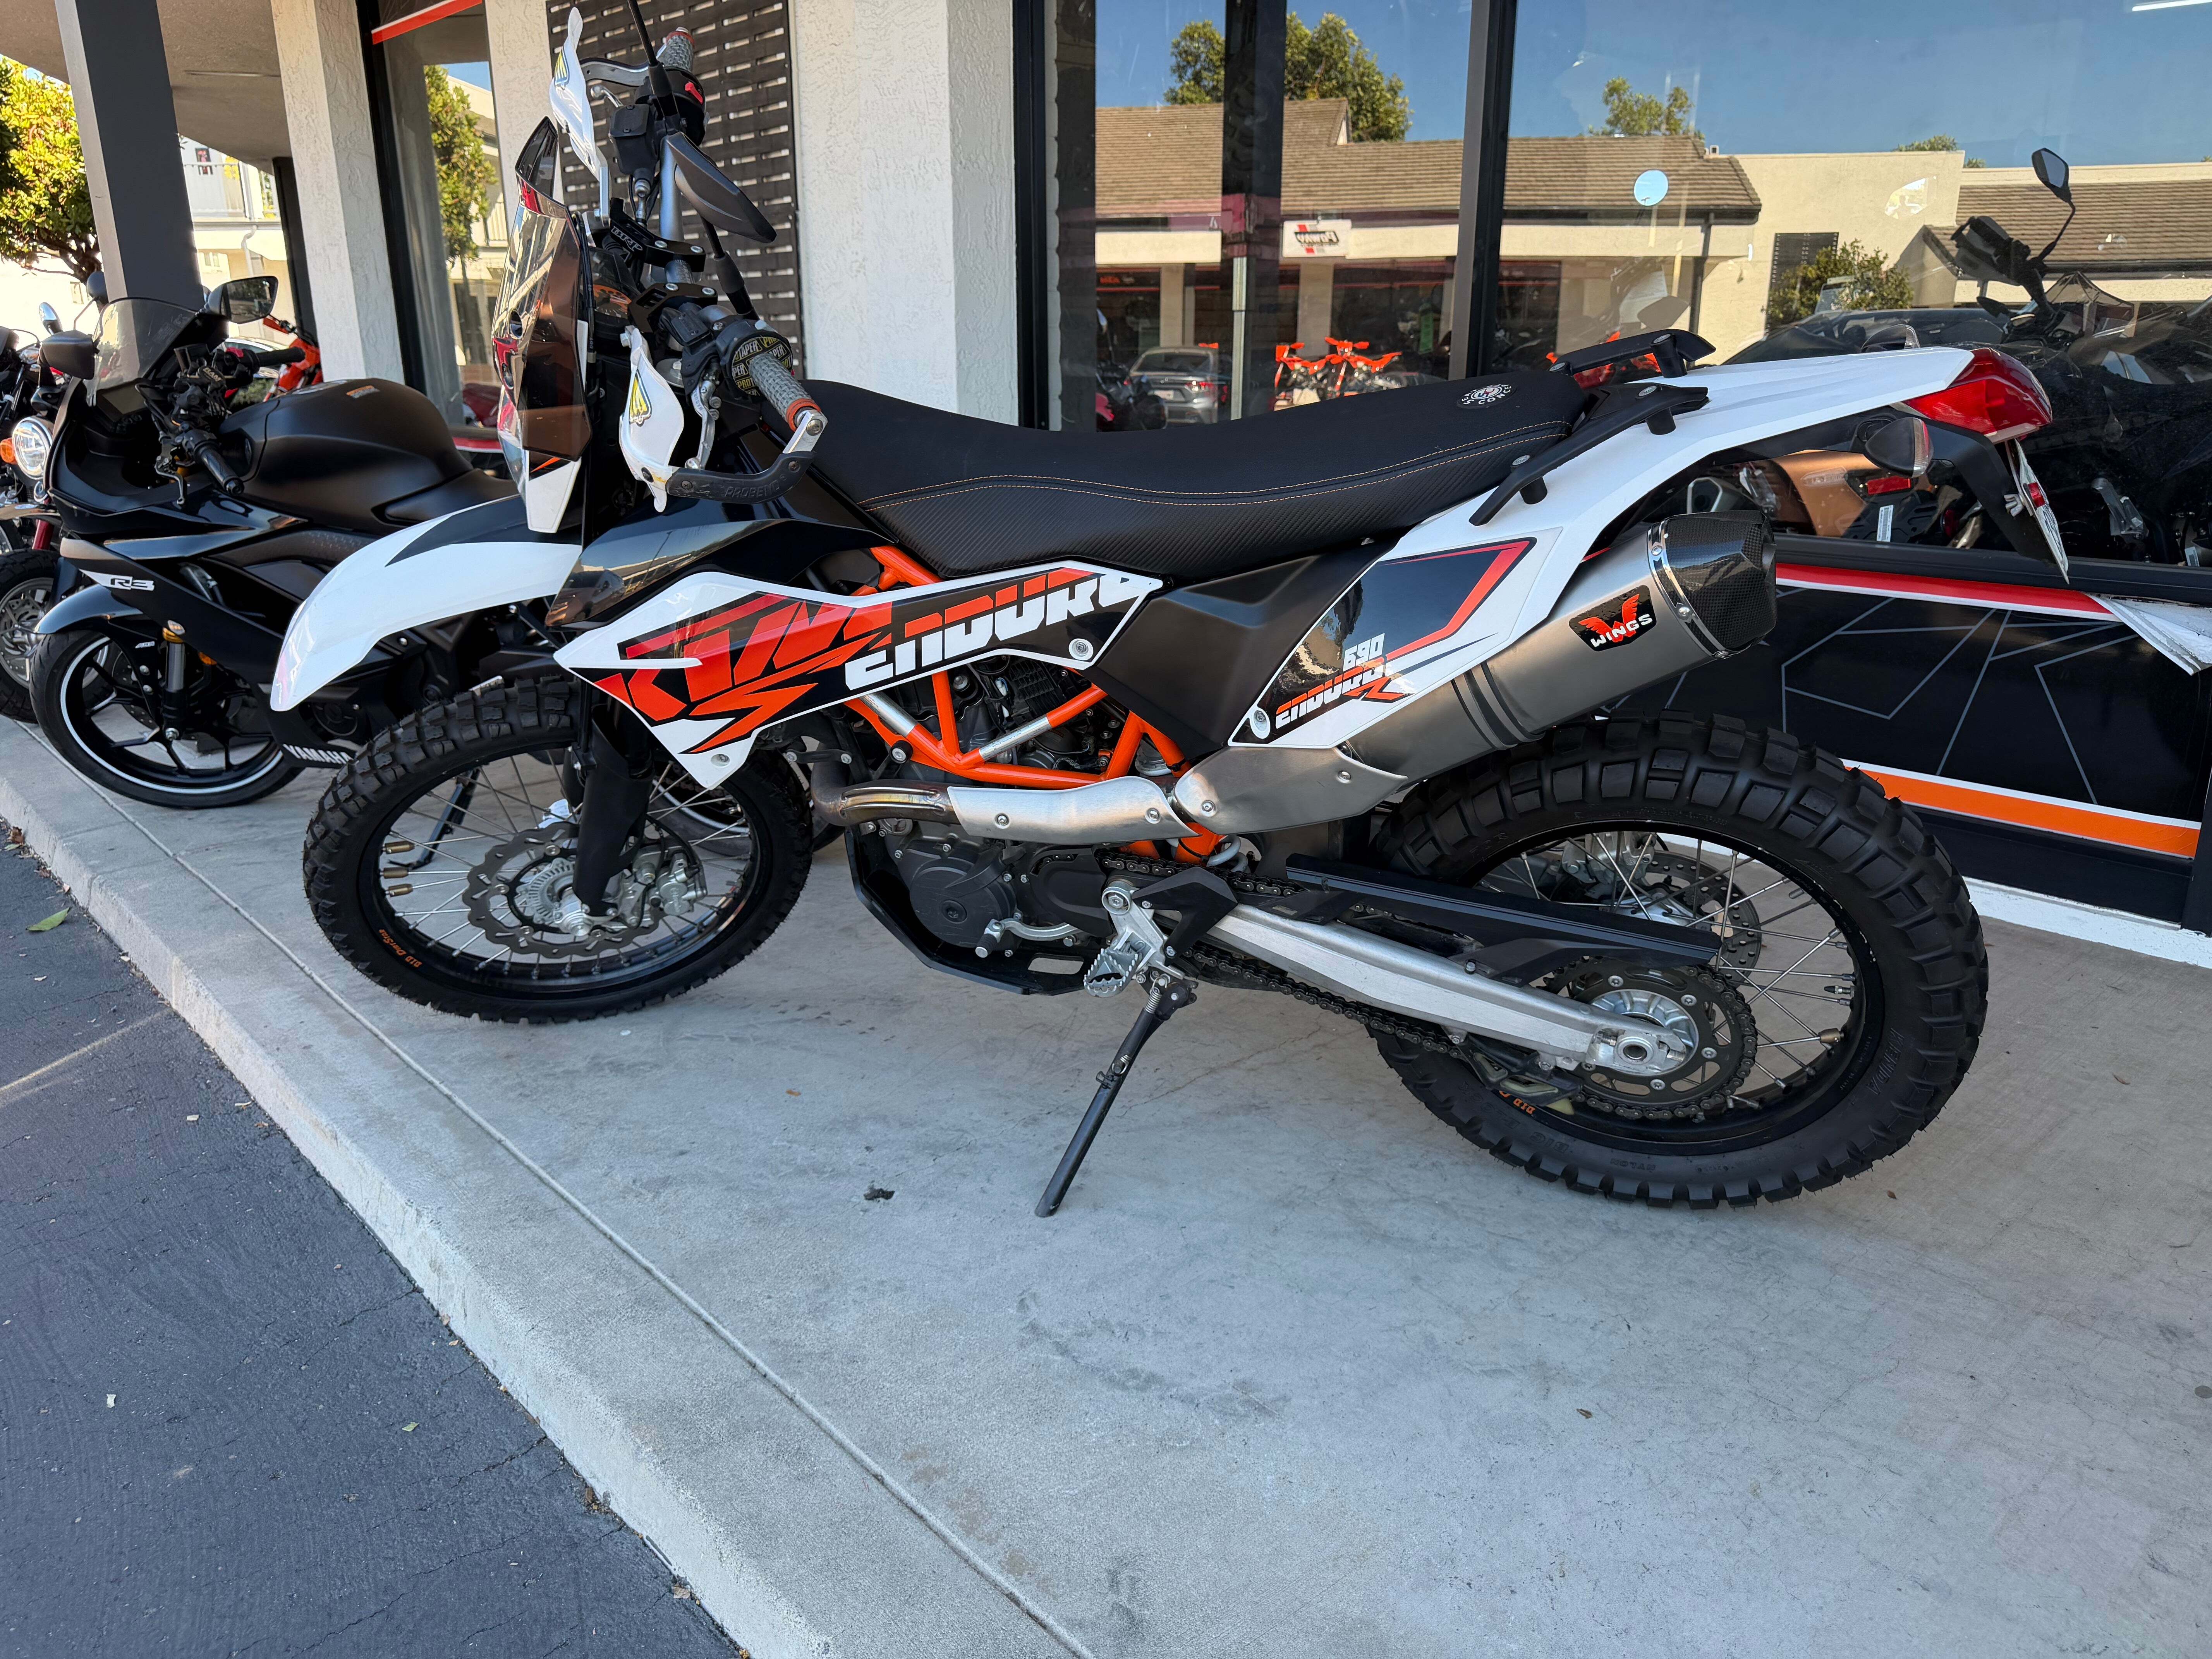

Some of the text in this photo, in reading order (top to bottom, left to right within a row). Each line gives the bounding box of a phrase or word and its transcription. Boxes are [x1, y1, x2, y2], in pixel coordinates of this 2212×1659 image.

[111, 577, 155, 591] R3
[1590, 613, 1653, 647] WINGS
[1343, 633, 1385, 672] 690
[1276, 657, 1385, 729] ENDURO
[282, 743, 354, 764] YAMAHA
[405, 955, 422, 967] DID
[1866, 1027, 1905, 1096] KENDA
[1513, 1097, 1536, 1115] DID
[1529, 1131, 1570, 1155] BIG
[1609, 1157, 1656, 1171] NYLON
